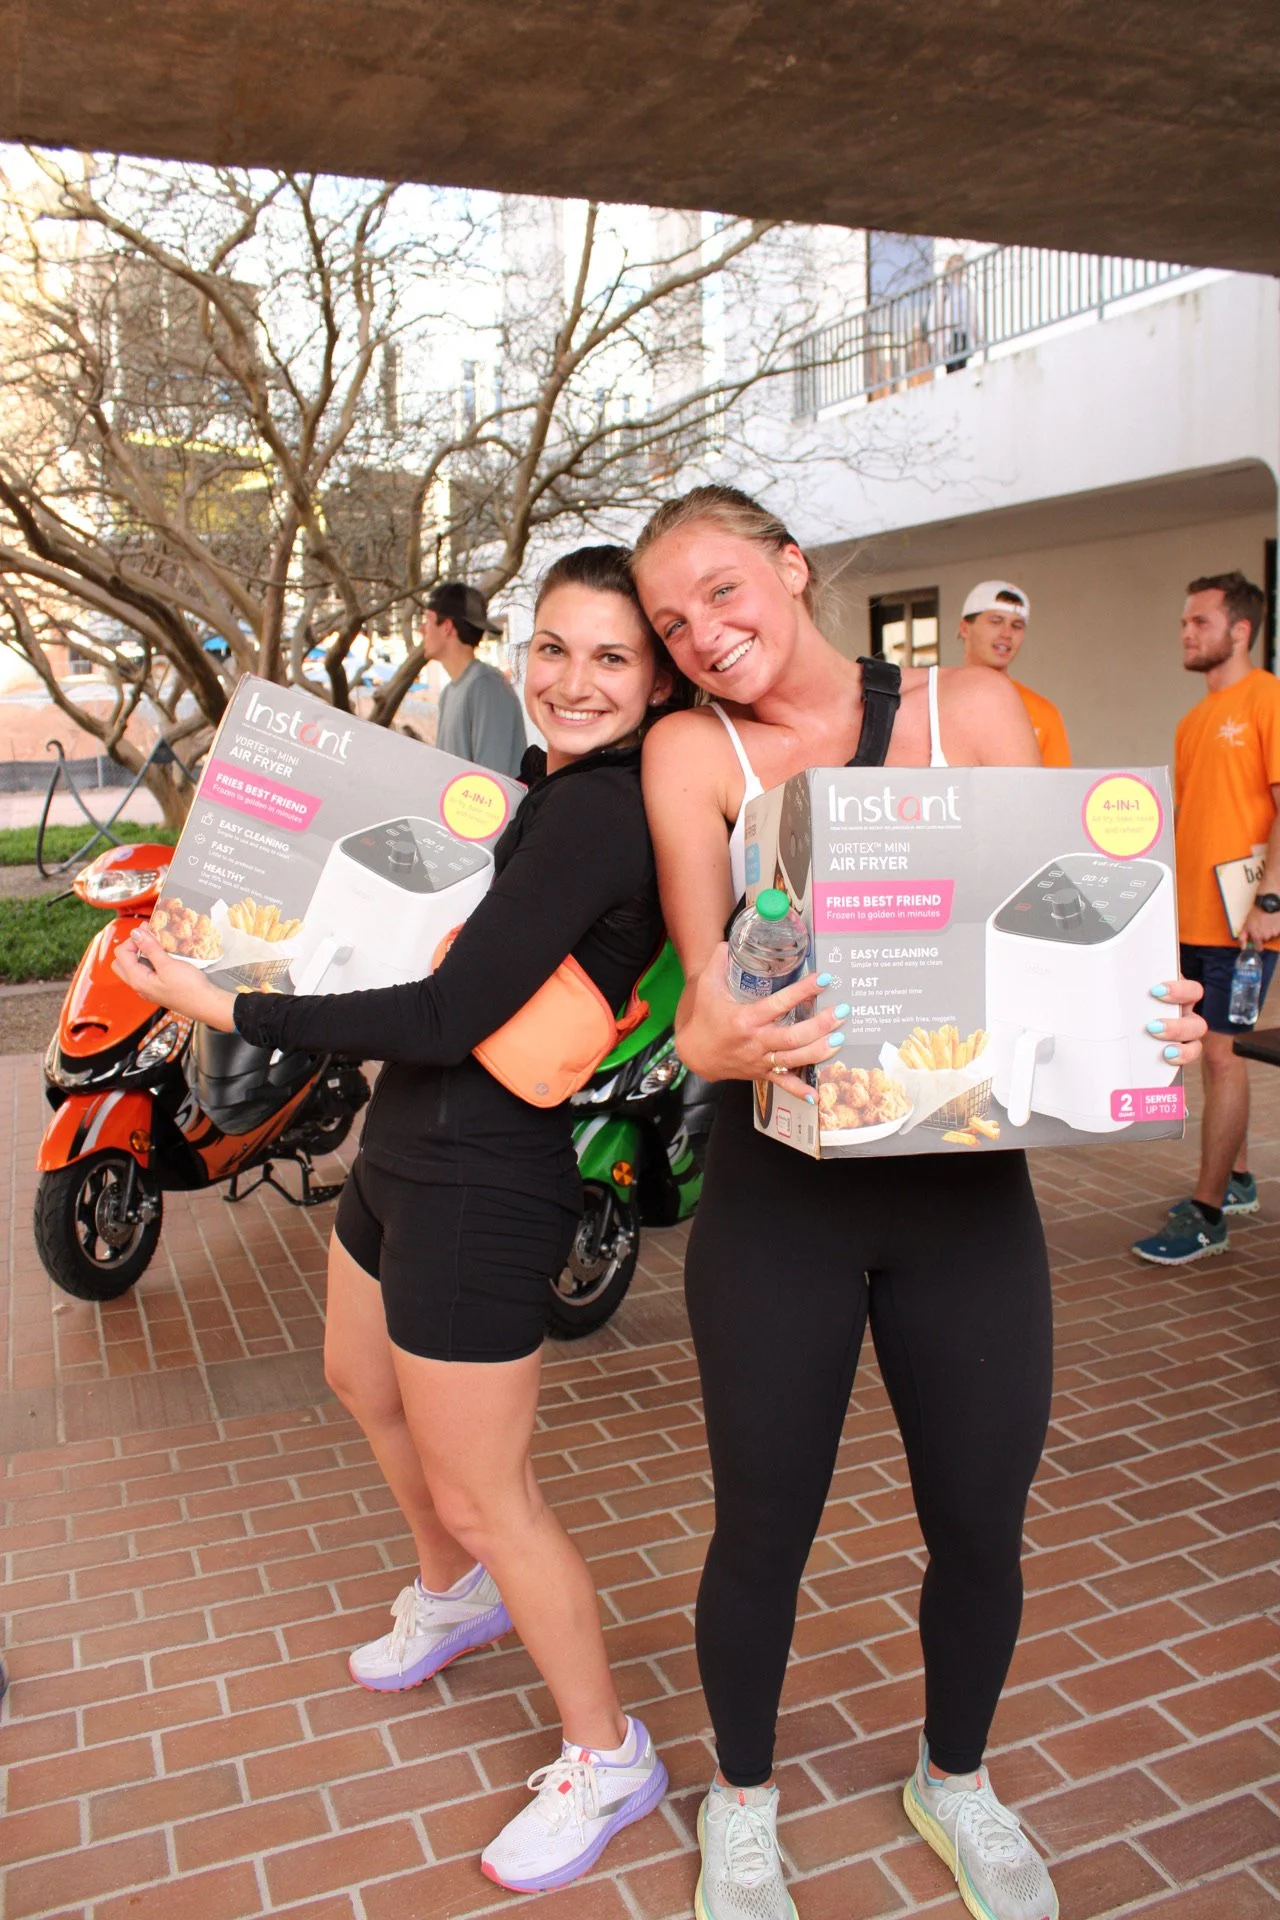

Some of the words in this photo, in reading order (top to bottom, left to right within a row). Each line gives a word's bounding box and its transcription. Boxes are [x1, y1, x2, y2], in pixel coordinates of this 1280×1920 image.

[245, 692, 353, 760] Instant
[229, 746, 252, 762] AIR
[253, 755, 293, 778] FRYER
[277, 751, 300, 766] MINI
[216, 773, 244, 790] FRIES
[244, 784, 271, 800] BEST
[270, 794, 307, 814] FRIEND
[462, 789, 492, 808] 4-IN-1
[212, 783, 236, 798] Frozen
[244, 795, 267, 810] golden
[268, 803, 275, 812] in
[276, 808, 303, 823] minutes
[828, 784, 961, 823] Instant
[1103, 799, 1140, 811] 4-IN-1
[219, 820, 243, 834] EASY
[244, 829, 290, 852] CLEANING
[211, 841, 235, 855] FAST
[885, 842, 910, 853] MINI
[830, 857, 856, 871] AIR
[860, 856, 909, 870] FRYER
[203, 861, 245, 882] HEALTHY
[826, 896, 861, 908] FRIES
[863, 895, 893, 907] BEST
[896, 894, 942, 907] FRIEND
[826, 911, 856, 920] Frozen
[858, 910, 866, 919] to
[867, 910, 896, 920] golden
[898, 909, 906, 918] in
[907, 909, 941, 918] minutes
[851, 948, 879, 960] EASY
[881, 947, 939, 959] CLEANING
[851, 977, 879, 988] FAST
[851, 1004, 903, 1016] HEALTHY
[1121, 1093, 1133, 1111] 2
[1145, 1094, 1178, 1104] SERVES
[1146, 1106, 1158, 1115] UP
[1159, 1105, 1170, 1114] TO
[1171, 1104, 1177, 1113] 2
